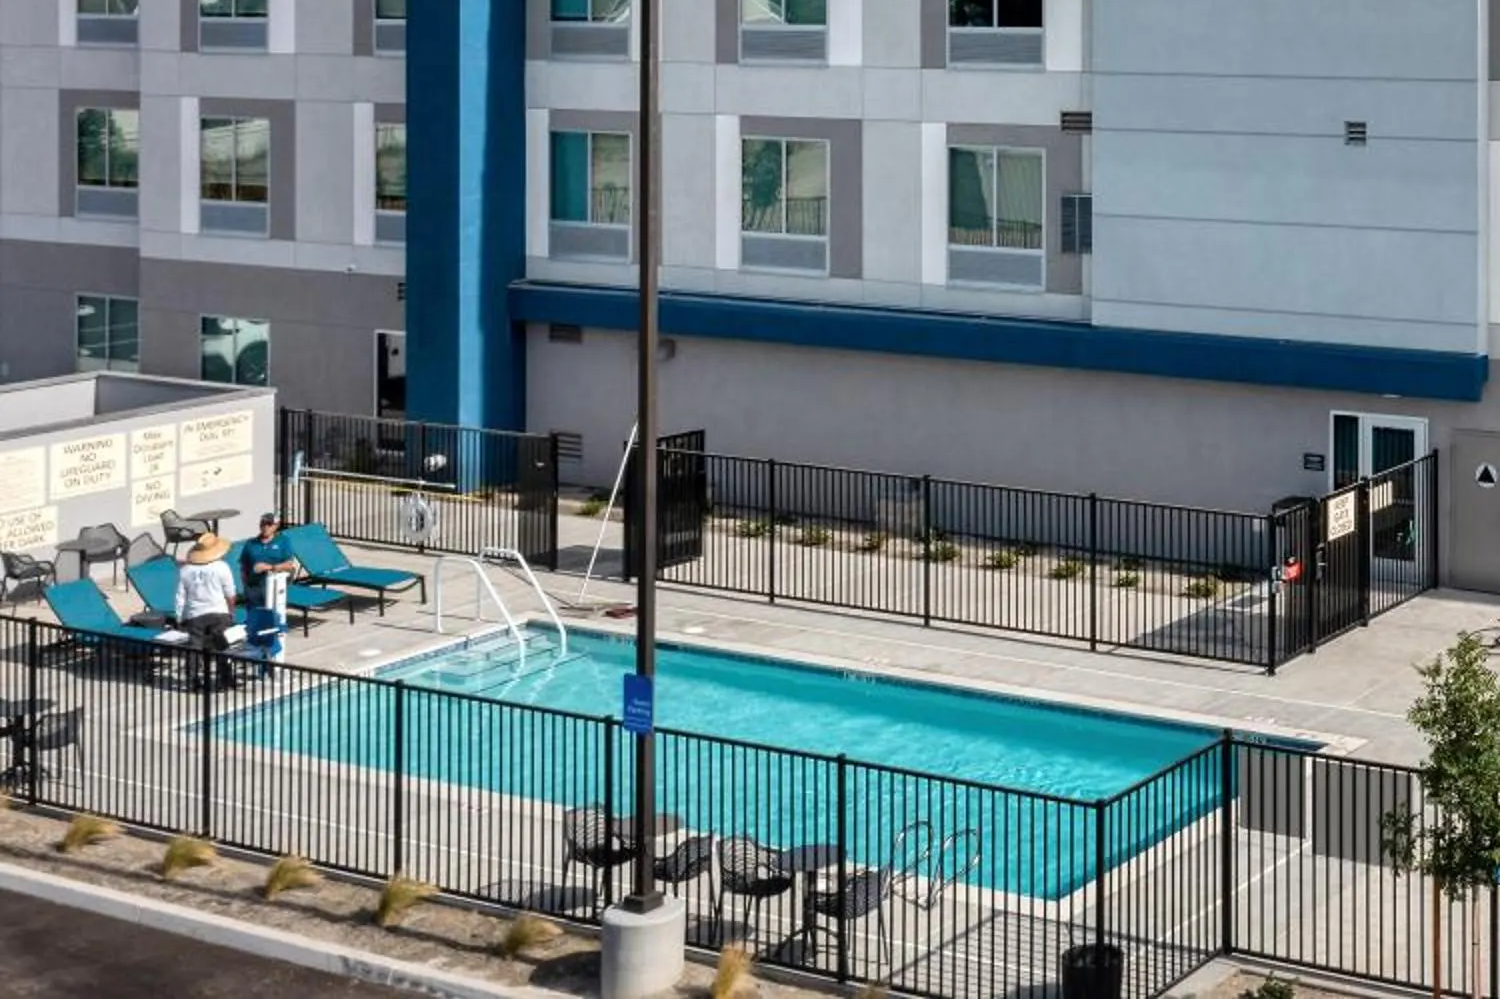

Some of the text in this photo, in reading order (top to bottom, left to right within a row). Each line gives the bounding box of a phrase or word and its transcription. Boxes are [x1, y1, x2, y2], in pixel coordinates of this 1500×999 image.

[196, 414, 249, 432] EMERGENCY
[63, 439, 113, 455] WARNING
[80, 452, 97, 462] NO
[60, 459, 116, 479] LIFEGUARD
[63, 471, 112, 489] ON DUTY
[145, 480, 162, 491] NO
[135, 489, 171, 505] DIVING
[7, 520, 55, 538] ALLOWED
